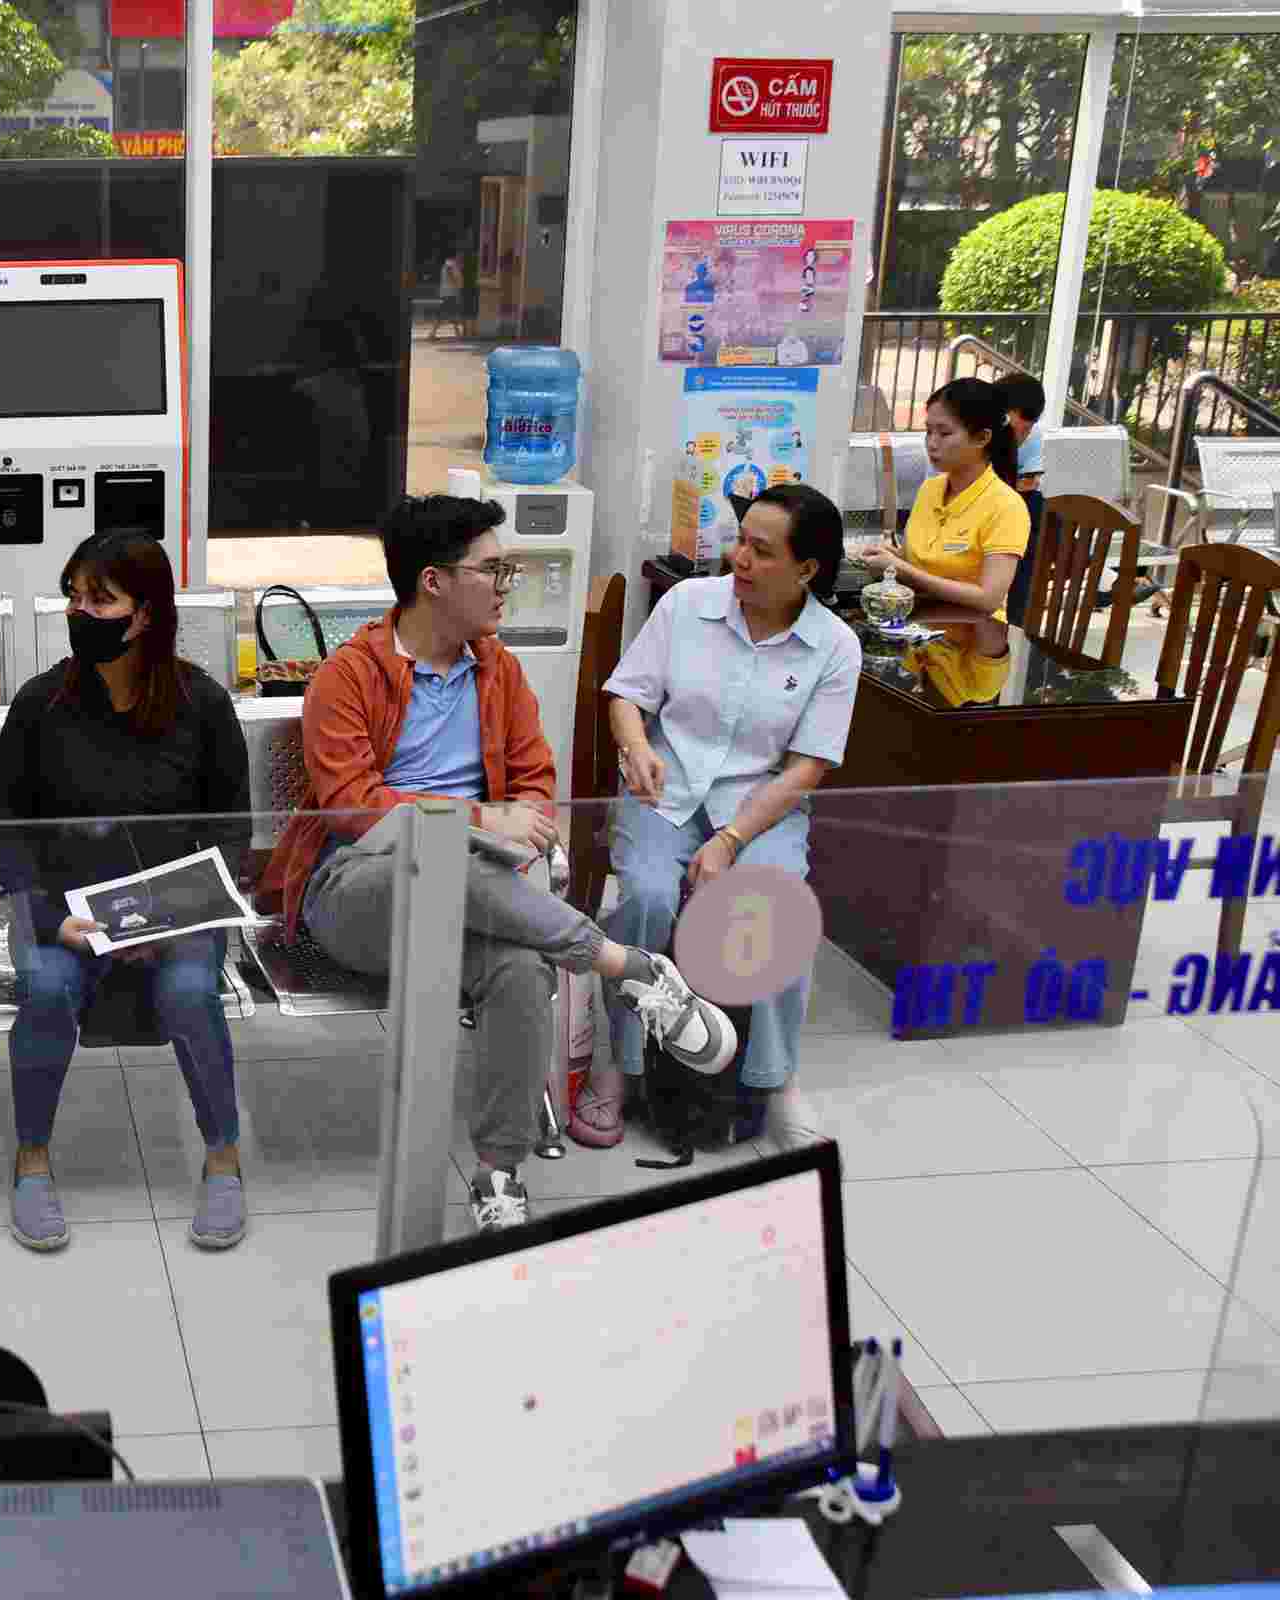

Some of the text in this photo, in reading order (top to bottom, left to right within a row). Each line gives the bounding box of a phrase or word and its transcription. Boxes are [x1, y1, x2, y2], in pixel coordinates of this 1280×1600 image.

[768, 72, 817, 96] CẤM
[761, 97, 820, 118] HÚT THUỐC
[738, 151, 790, 168] WIFI
[715, 223, 806, 236] VIRUS CORONA
